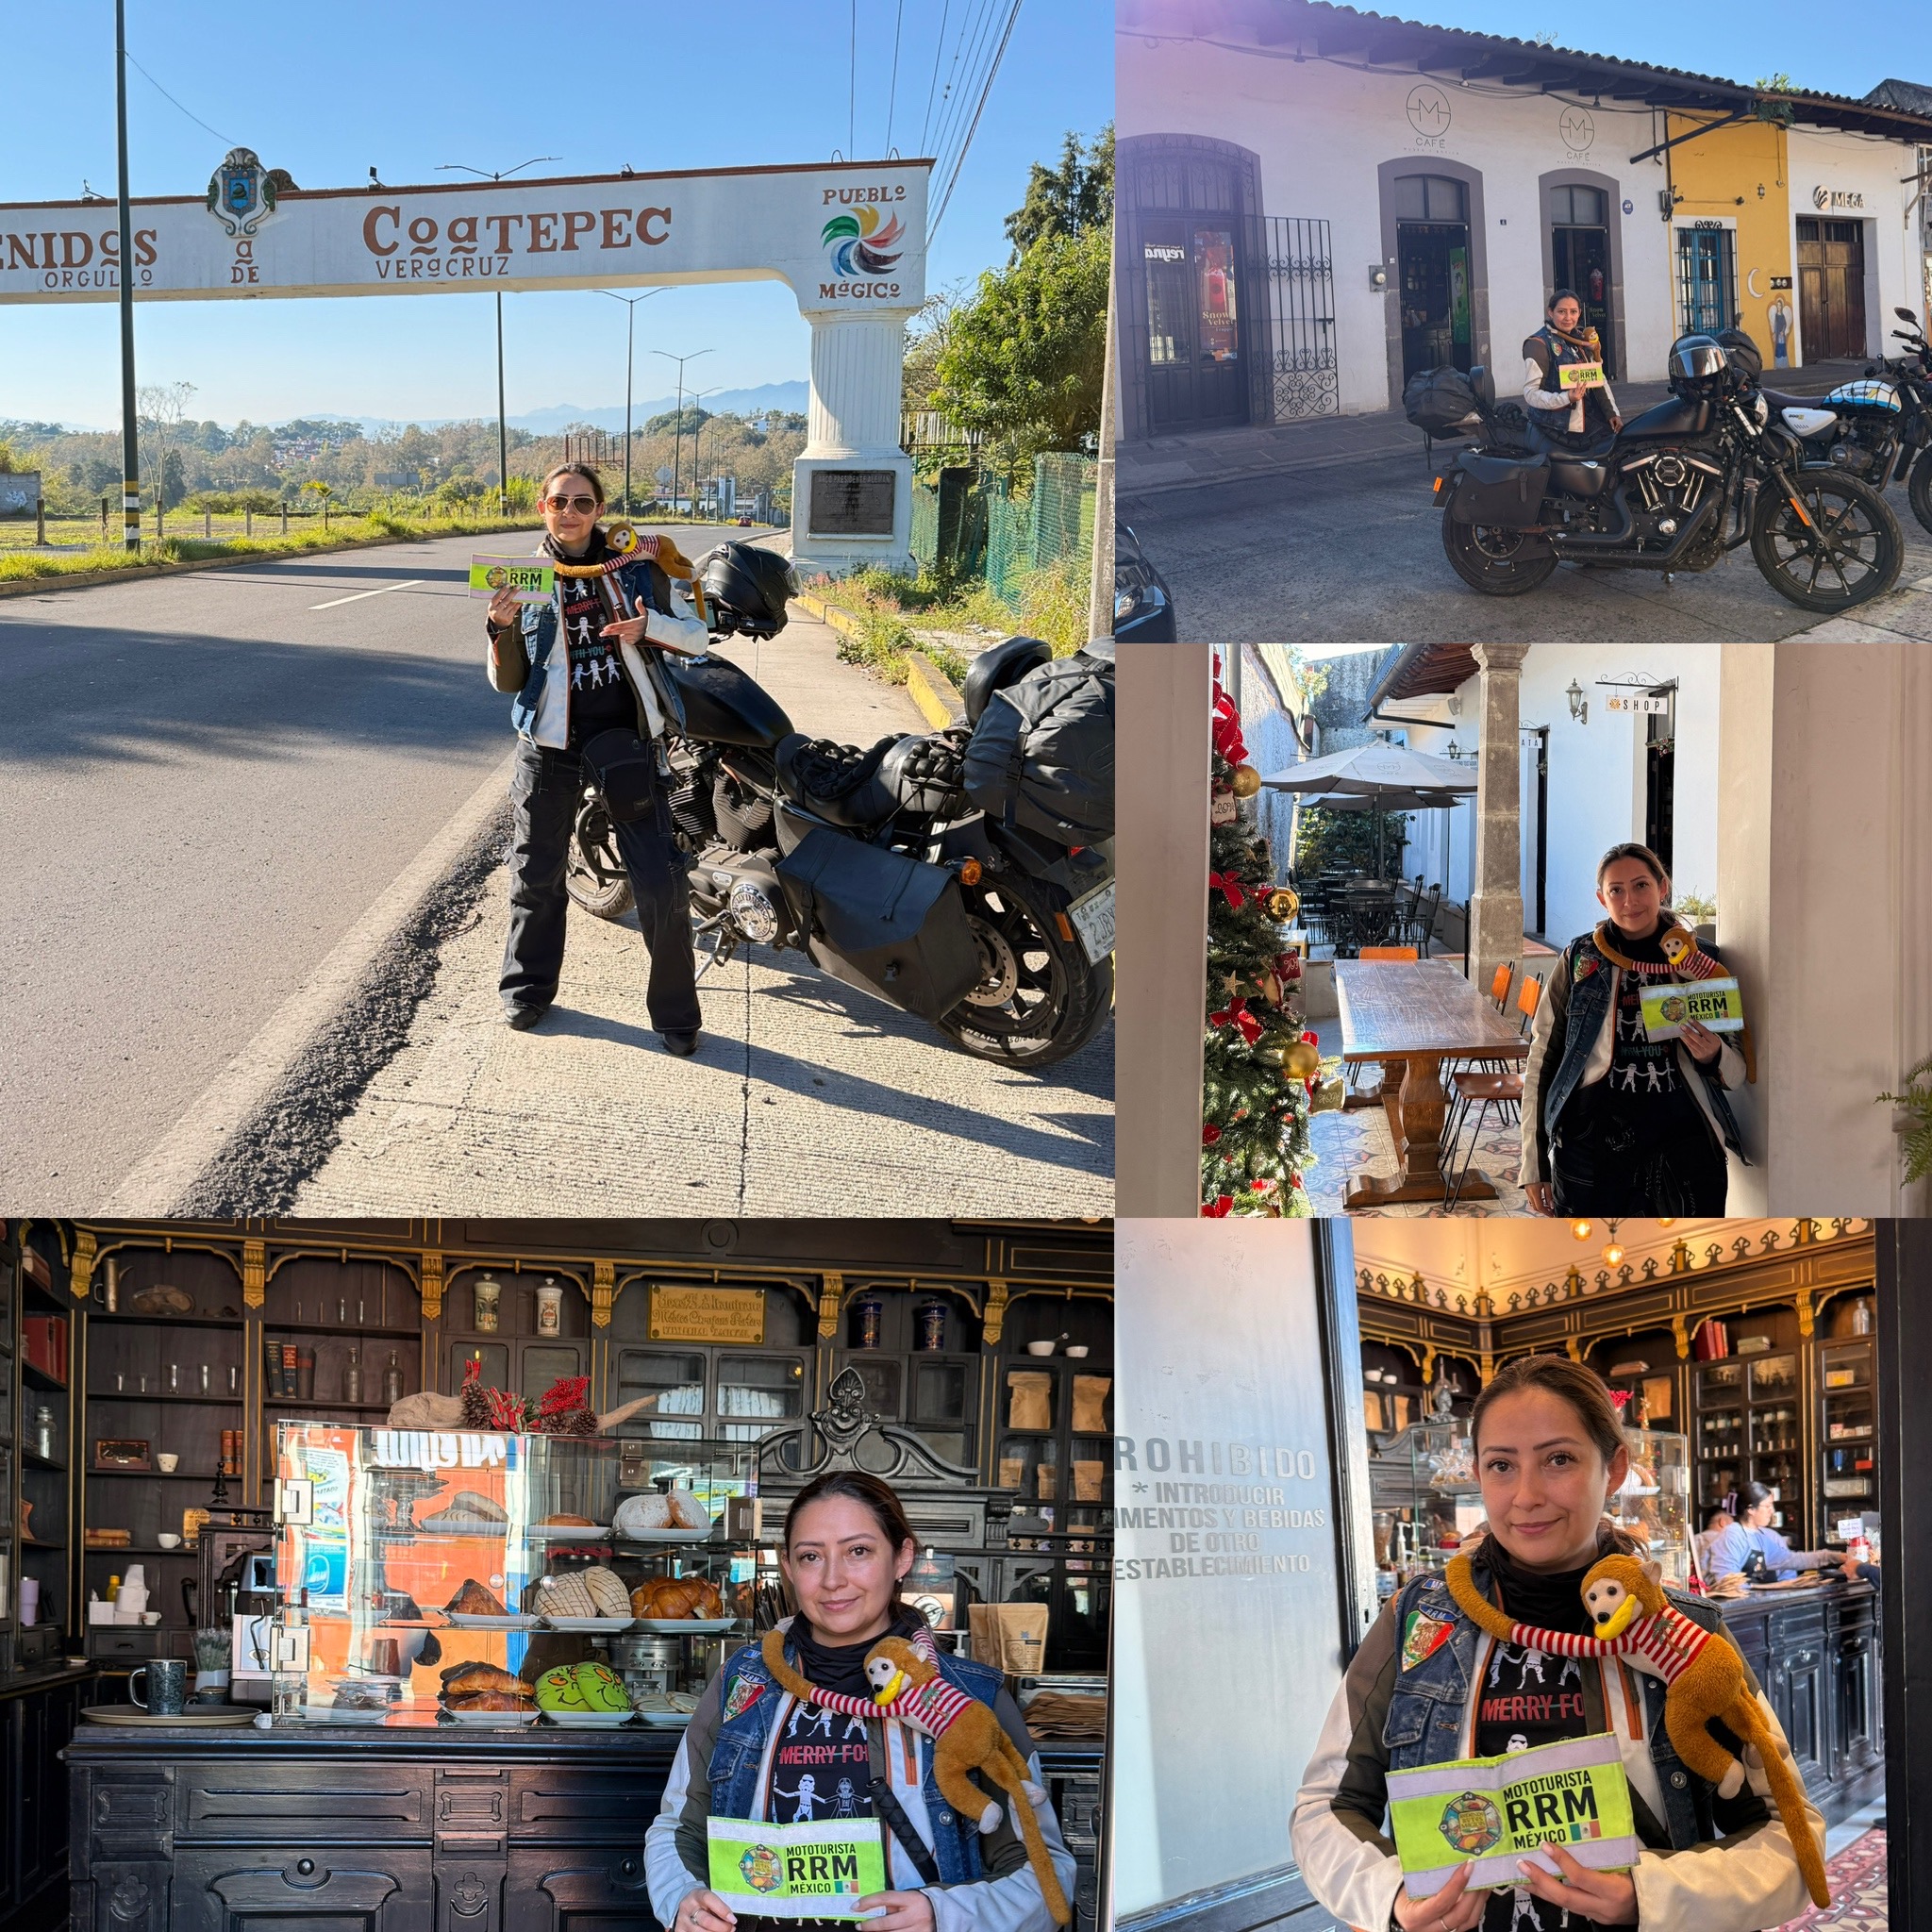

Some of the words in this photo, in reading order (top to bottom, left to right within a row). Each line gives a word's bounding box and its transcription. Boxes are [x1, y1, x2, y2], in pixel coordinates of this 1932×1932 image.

[1835, 192, 1866, 208] MEGA
[230, 266, 259, 284] DE
[510, 573, 541, 585] RRM
[566, 600, 594, 614] MERRY
[588, 645, 605, 657] YOU
[1623, 699, 1660, 711] SHOP
[1687, 991, 1725, 1000] MOTOTURISTA
[1689, 998, 1728, 1013] RRM
[1641, 1045, 1661, 1057] YOU
[1156, 1482, 1286, 1506] INTRODUCIR
[1223, 1508, 1238, 1529] Y
[1244, 1508, 1325, 1529] BEBIDAS
[1170, 1532, 1201, 1554] DE
[1206, 1532, 1261, 1553] OTRO
[1426, 1607, 1447, 1620] RRM
[1481, 1693, 1553, 1721] MERRY
[778, 1744, 837, 1765] MERRY
[1503, 1770, 1592, 1802] MOTOTURISTA
[1506, 1785, 1599, 1833] RRM
[1513, 1828, 1566, 1849] MÉXICO
[787, 1843, 857, 1857] MOTOTURISTA
[787, 1855, 858, 1881] RRM
[791, 1882, 831, 1894] MÉXICO
